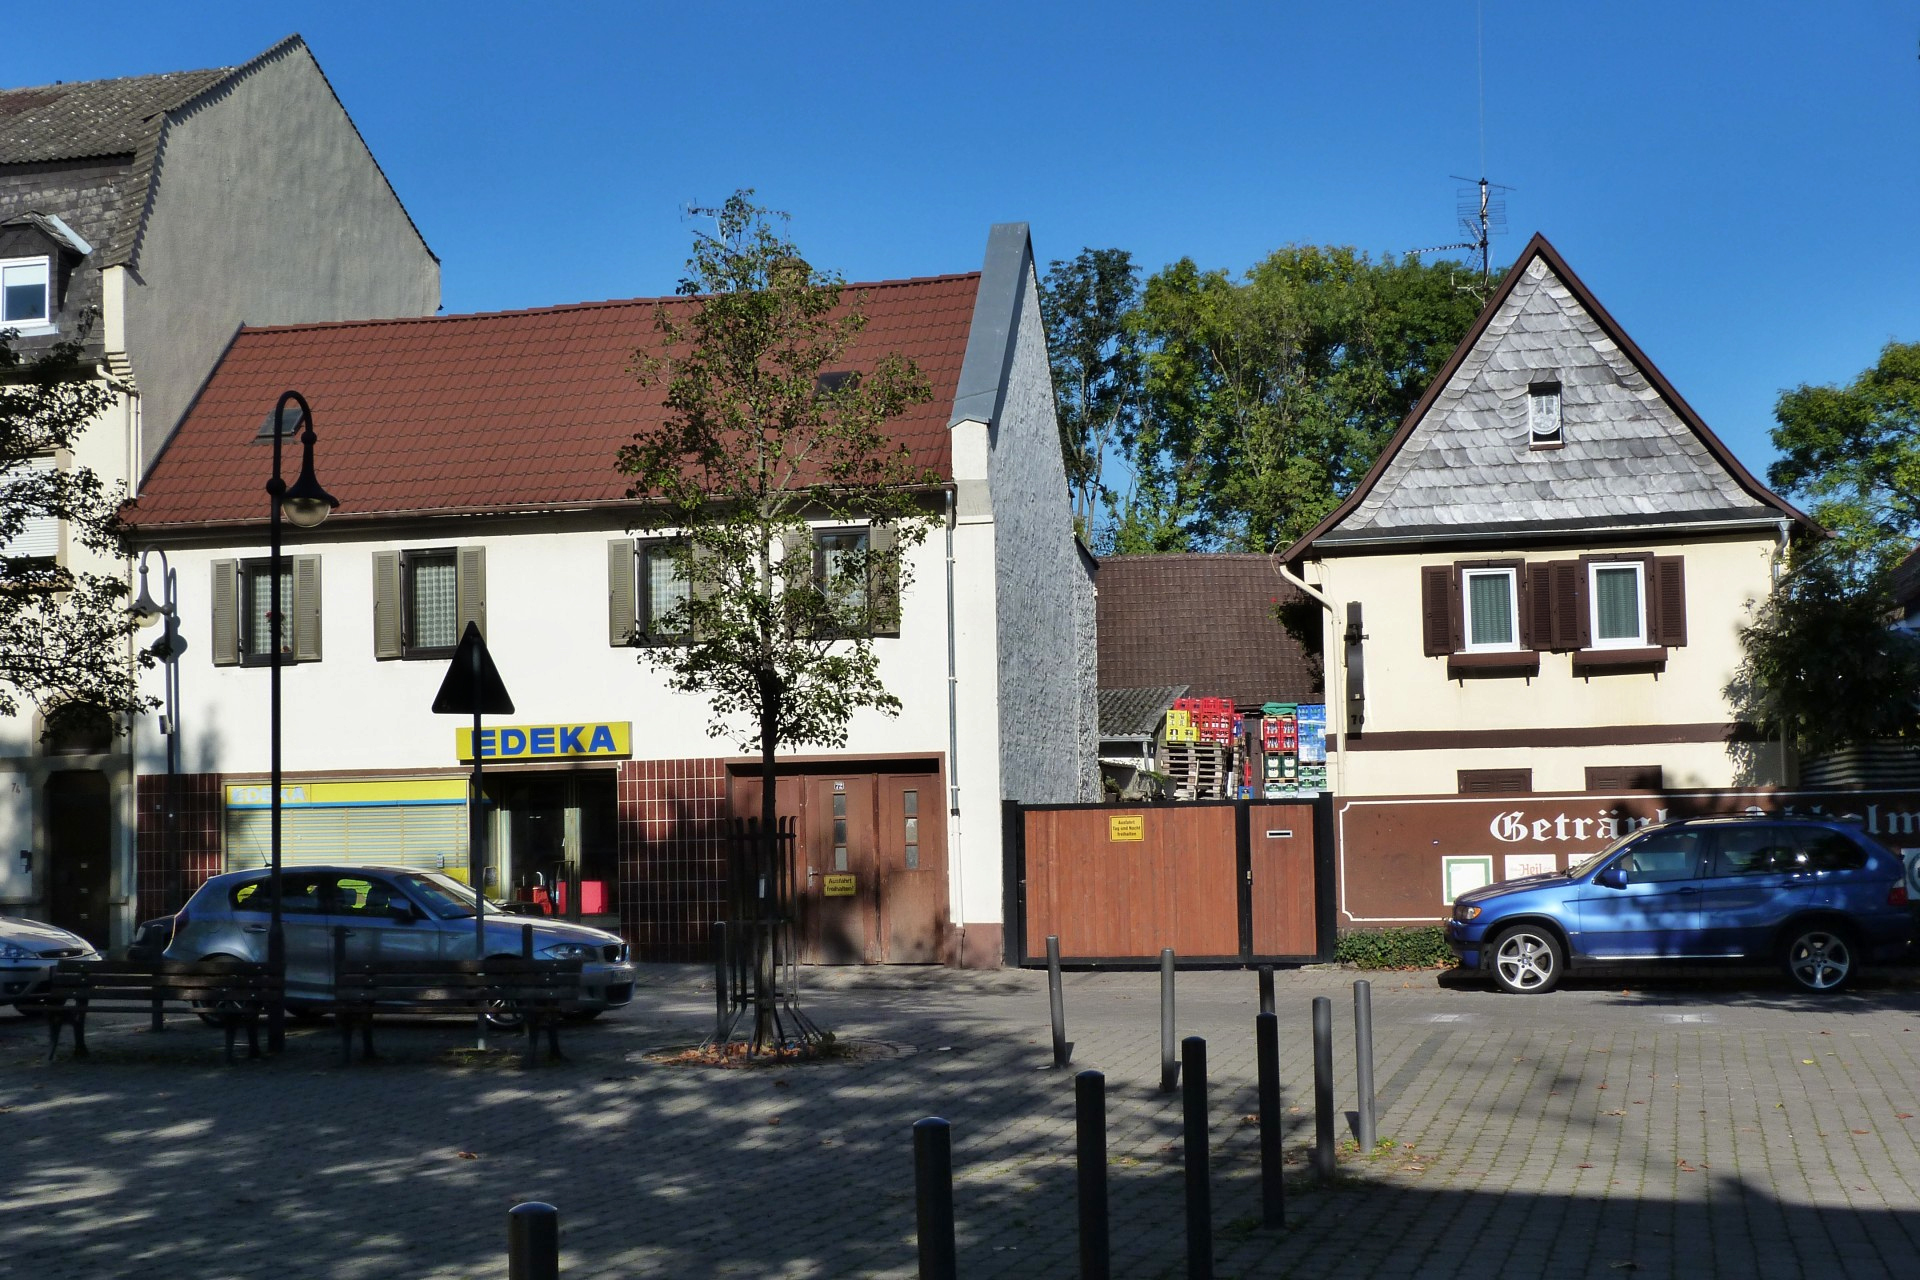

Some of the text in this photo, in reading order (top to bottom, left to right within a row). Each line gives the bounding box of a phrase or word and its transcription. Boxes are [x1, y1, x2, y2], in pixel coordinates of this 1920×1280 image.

[1351, 714, 1365, 725] 70
[471, 725, 617, 756] EDEKA
[231, 786, 306, 803] EDEKA
